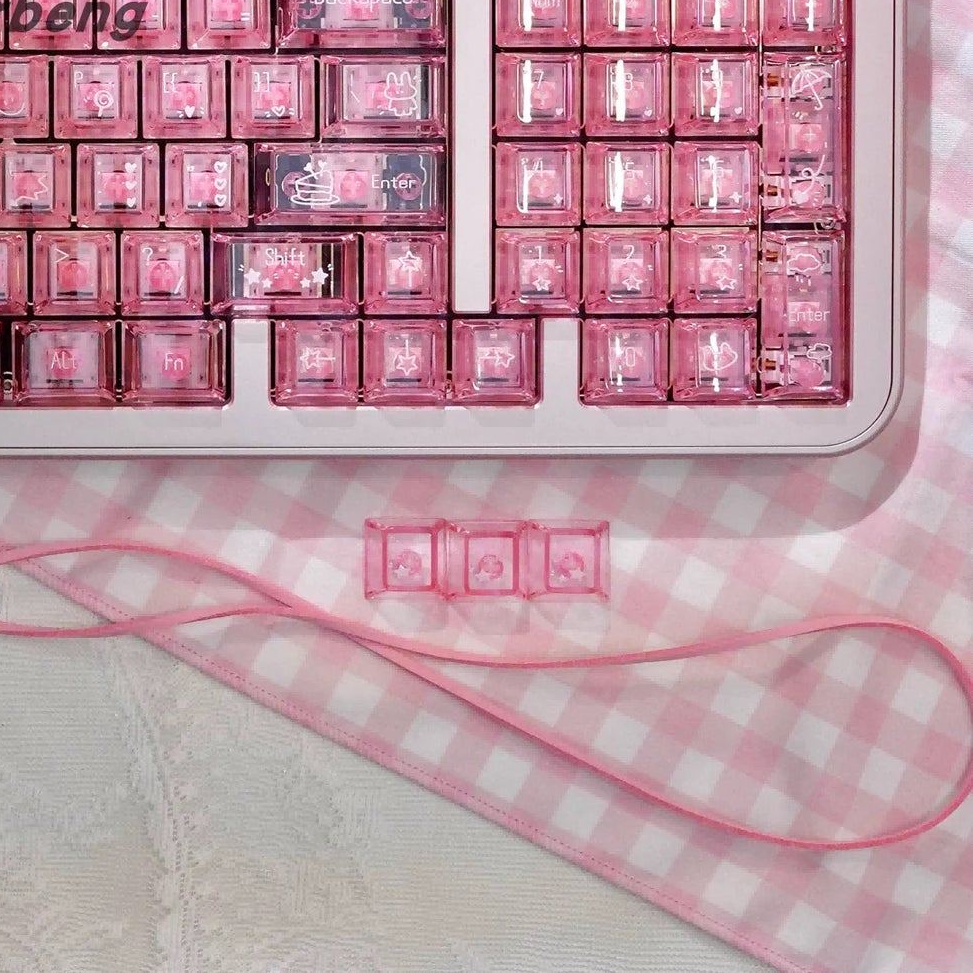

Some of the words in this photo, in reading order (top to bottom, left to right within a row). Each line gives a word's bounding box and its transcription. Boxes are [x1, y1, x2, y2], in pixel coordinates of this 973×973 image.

[74, 72, 83, 88] P
[534, 70, 545, 89] 7
[372, 175, 416, 189] Enter
[142, 247, 153, 266] ?
[265, 248, 305, 266] Shift
[624, 245, 635, 262] 2
[788, 307, 831, 323] Enter
[165, 353, 184, 371] Fn
